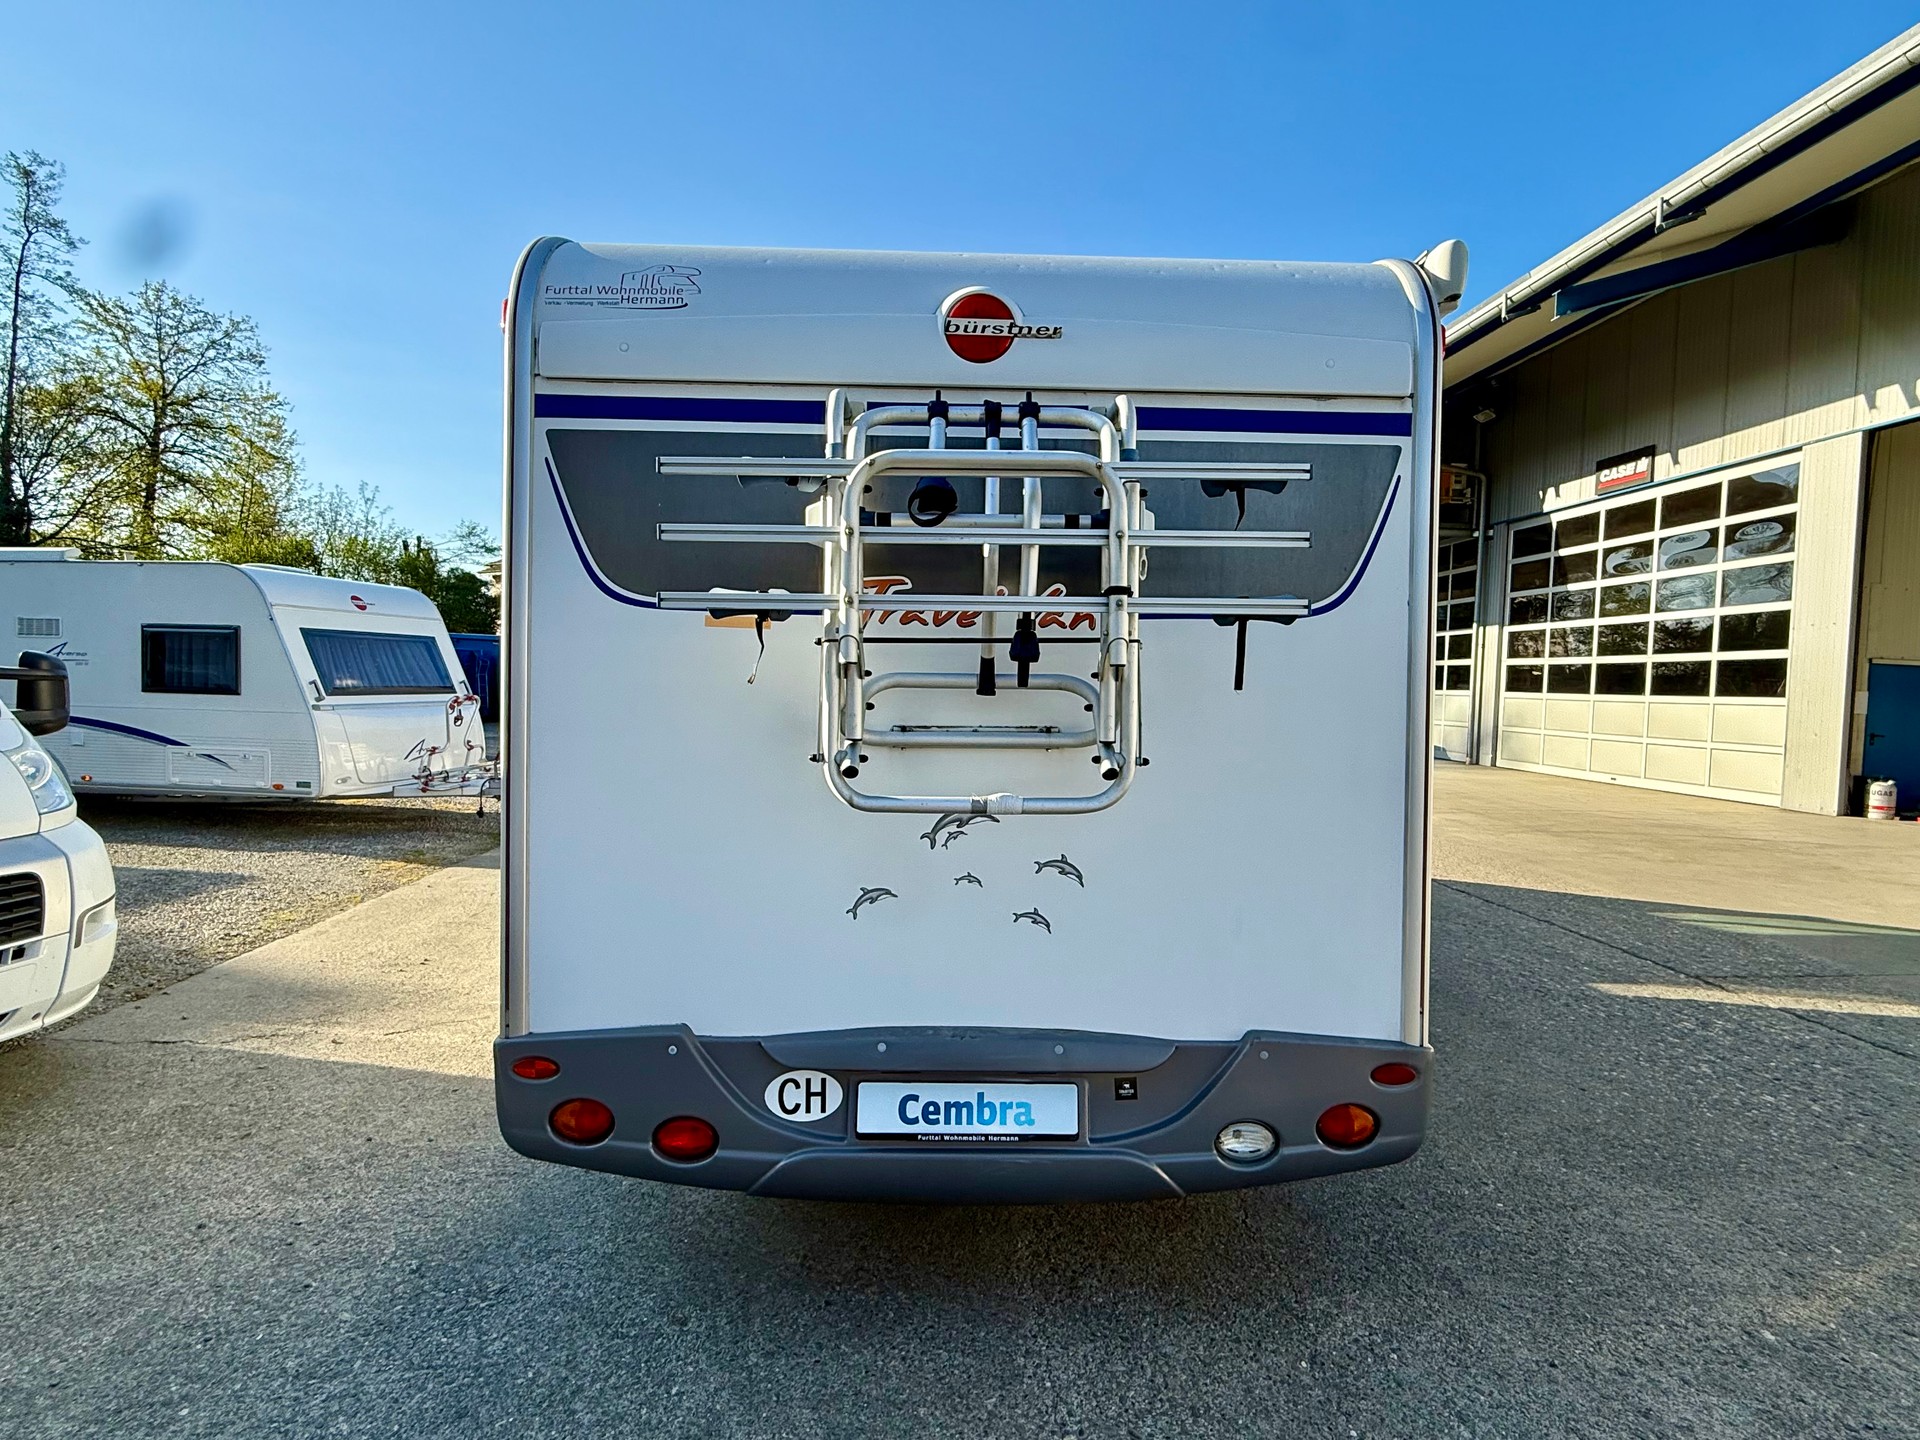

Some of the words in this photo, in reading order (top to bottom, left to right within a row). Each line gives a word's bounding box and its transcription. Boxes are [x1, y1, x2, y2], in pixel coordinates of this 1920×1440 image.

[545, 285, 592, 295] Furttal
[597, 285, 684, 296] Wohnmobile
[620, 294, 684, 305] Hermann
[945, 320, 1062, 336] bürstner
[1599, 461, 1636, 483] CASE
[863, 577, 1008, 629] Trave
[778, 1077, 827, 1115] CH
[898, 1093, 1035, 1127] Cembra
